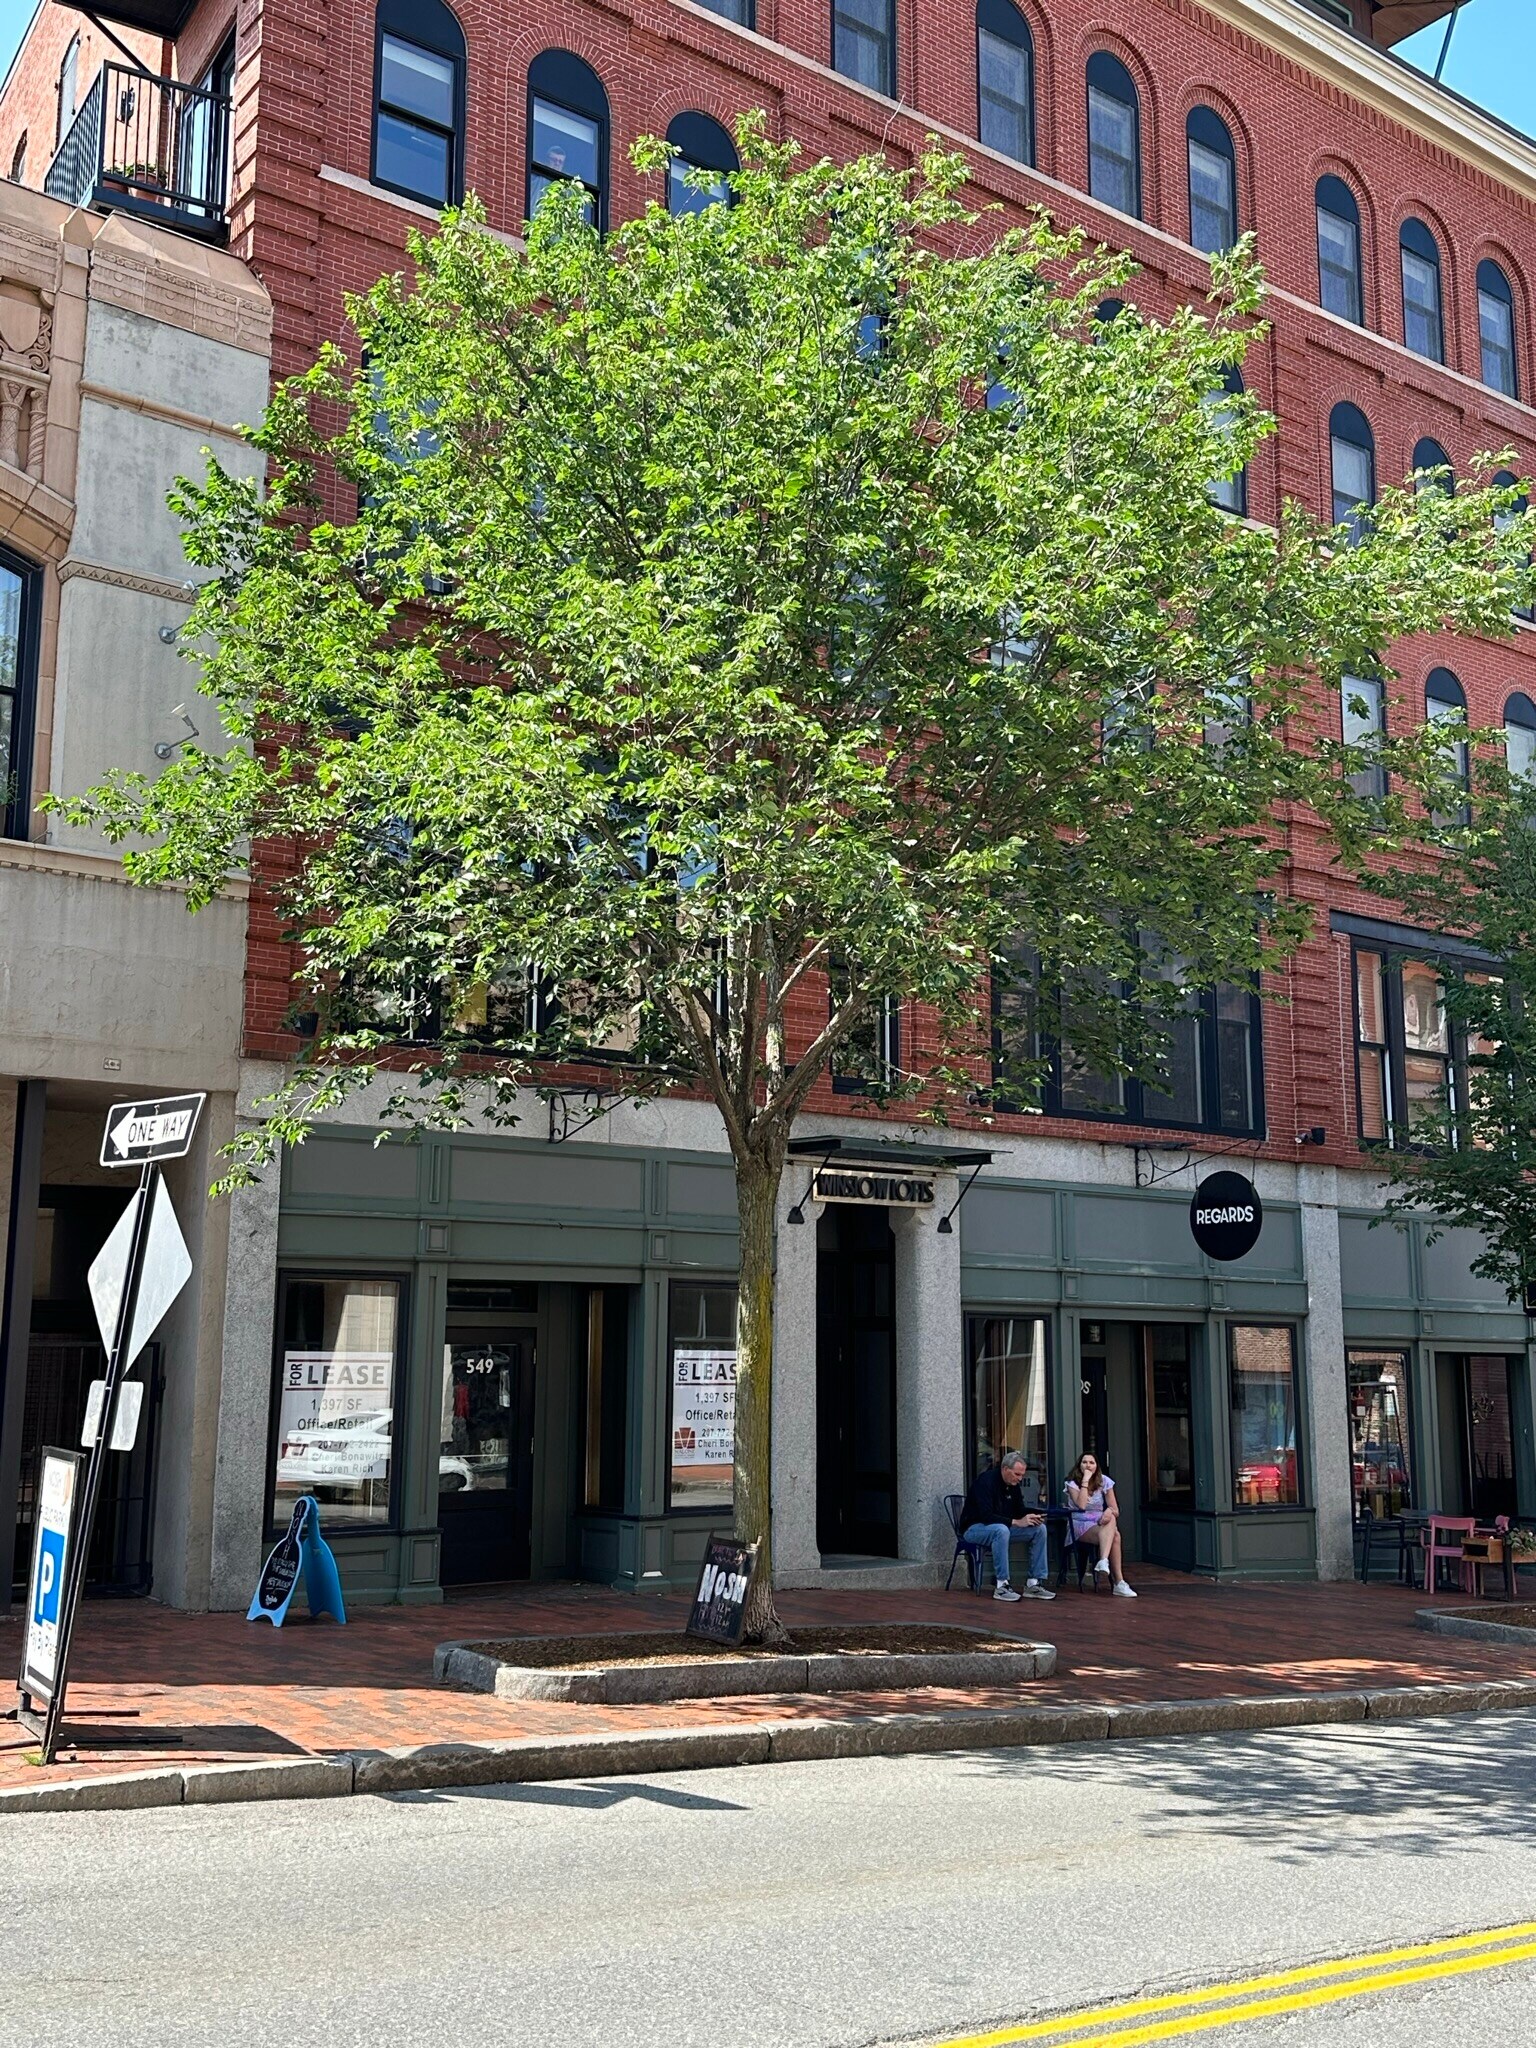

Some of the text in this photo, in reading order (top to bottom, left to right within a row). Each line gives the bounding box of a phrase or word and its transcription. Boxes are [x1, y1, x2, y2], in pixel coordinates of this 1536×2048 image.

[128, 1115, 188, 1143] ONE WAY
[1196, 1205, 1254, 1225] REGARDS
[289, 1363, 302, 1386] FOR
[307, 1365, 385, 1385] LEASE
[466, 1358, 494, 1374] 549
[678, 1361, 688, 1382] FOR
[691, 1363, 737, 1381] LEAS
[311, 1398, 362, 1412] 1,397 SF
[695, 1392, 719, 1405] 1,397
[704, 1450, 727, 1459] Karen
[38, 1550, 55, 1616] P
[697, 1563, 748, 1604] NOSH
